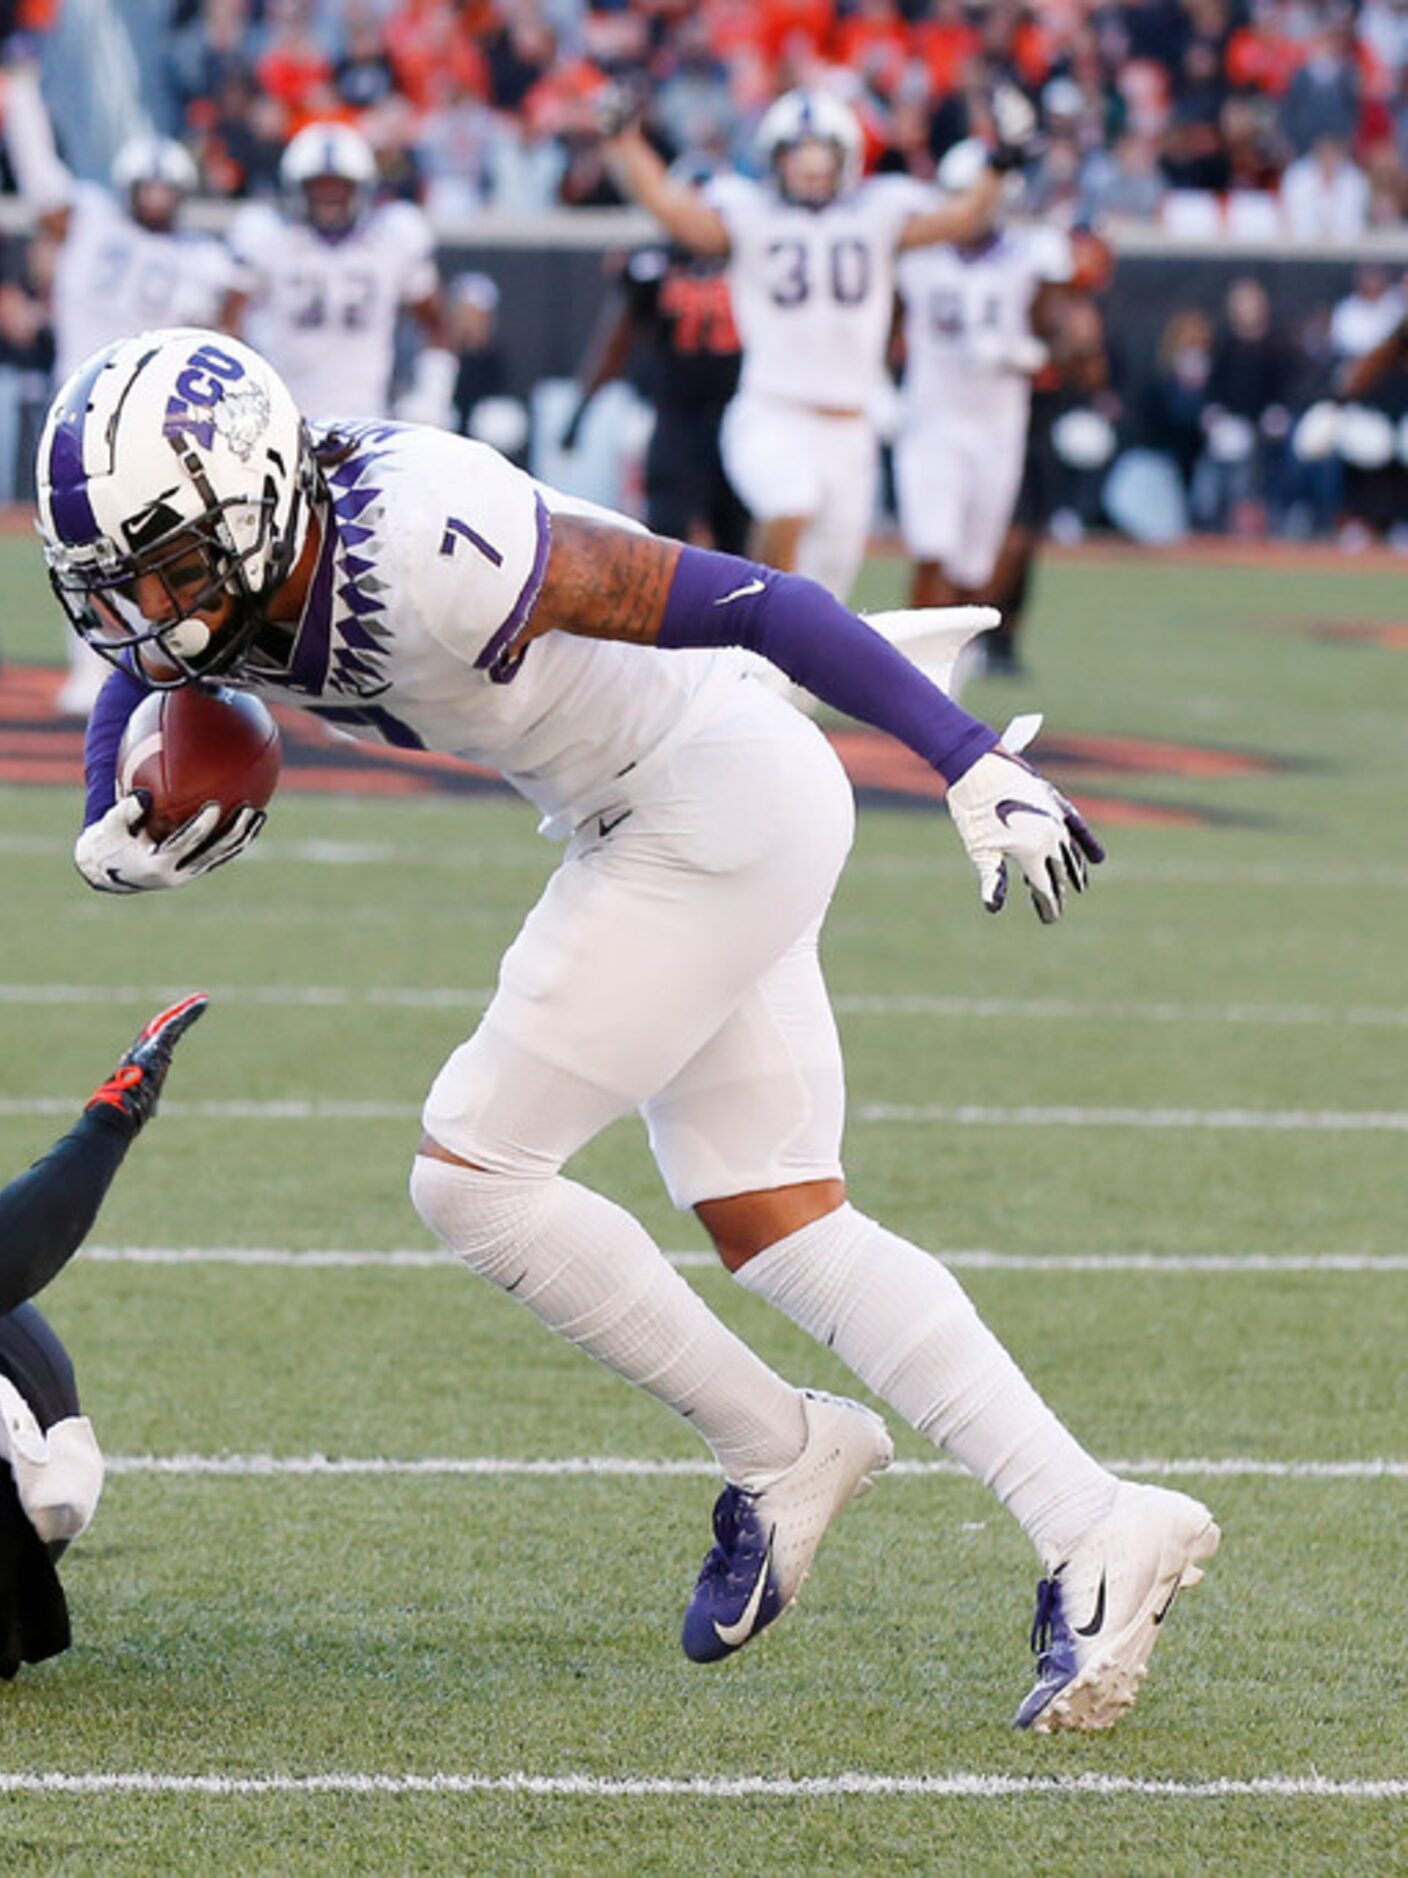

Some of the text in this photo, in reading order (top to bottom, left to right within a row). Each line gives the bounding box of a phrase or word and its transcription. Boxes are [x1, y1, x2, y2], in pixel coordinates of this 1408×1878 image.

[769, 238, 869, 309] 30
[162, 344, 245, 451] TCU
[439, 515, 504, 568] 7
